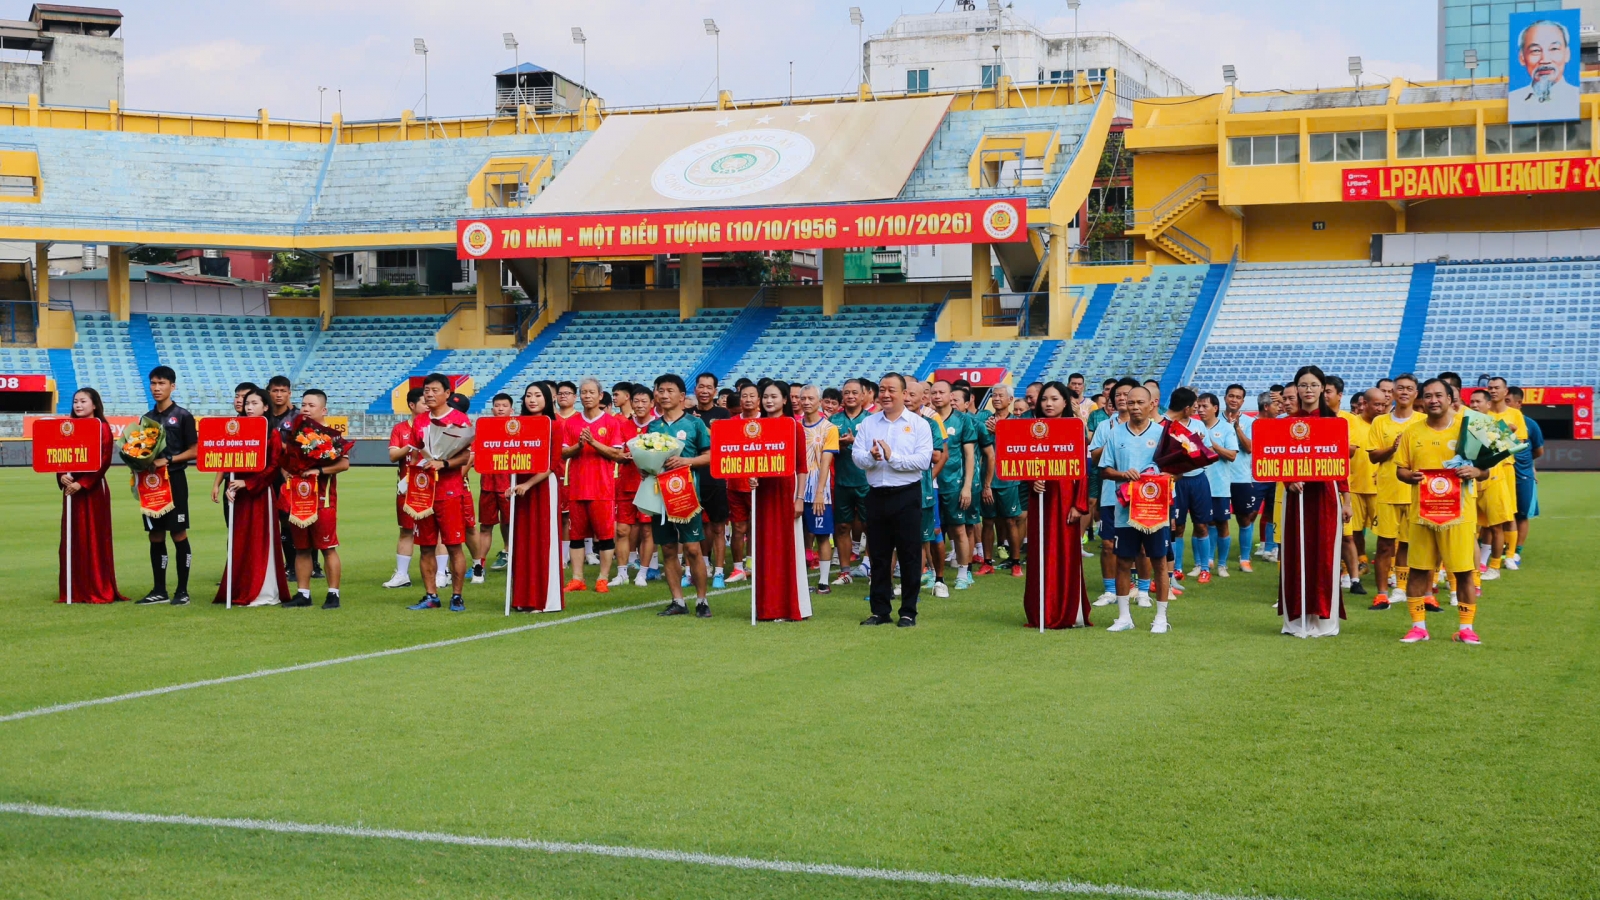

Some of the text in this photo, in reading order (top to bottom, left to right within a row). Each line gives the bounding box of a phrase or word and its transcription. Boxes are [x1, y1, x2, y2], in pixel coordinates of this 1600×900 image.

[1379, 165, 1463, 197] LPBANK
[501, 229, 520, 248] 70
[526, 225, 562, 248] NĂM
[579, 223, 615, 249] MỘT
[620, 218, 658, 245] BIỂU
[663, 220, 721, 247] TƯỢNG
[726, 218, 837, 242] (10/10/1956
[854, 212, 972, 238] 10/10/2026)
[960, 371, 981, 383] 10
[47, 445, 88, 466] TRỌNG TÀI
[765, 441, 785, 450] THỦ
[1053, 442, 1074, 452] THỦ
[1314, 443, 1338, 453] THỦ
[205, 450, 257, 470] CÔNG AN HÀ NỘI
[511, 452, 531, 471] CÔNG
[720, 453, 785, 474] CÔNG AN HÀ NỘI
[1001, 457, 1080, 479] M.A.Y VIỆT NAM FC
[1256, 456, 1345, 477] CÔNG AN HẢI PHÒNG
[815, 516, 824, 528] 12
